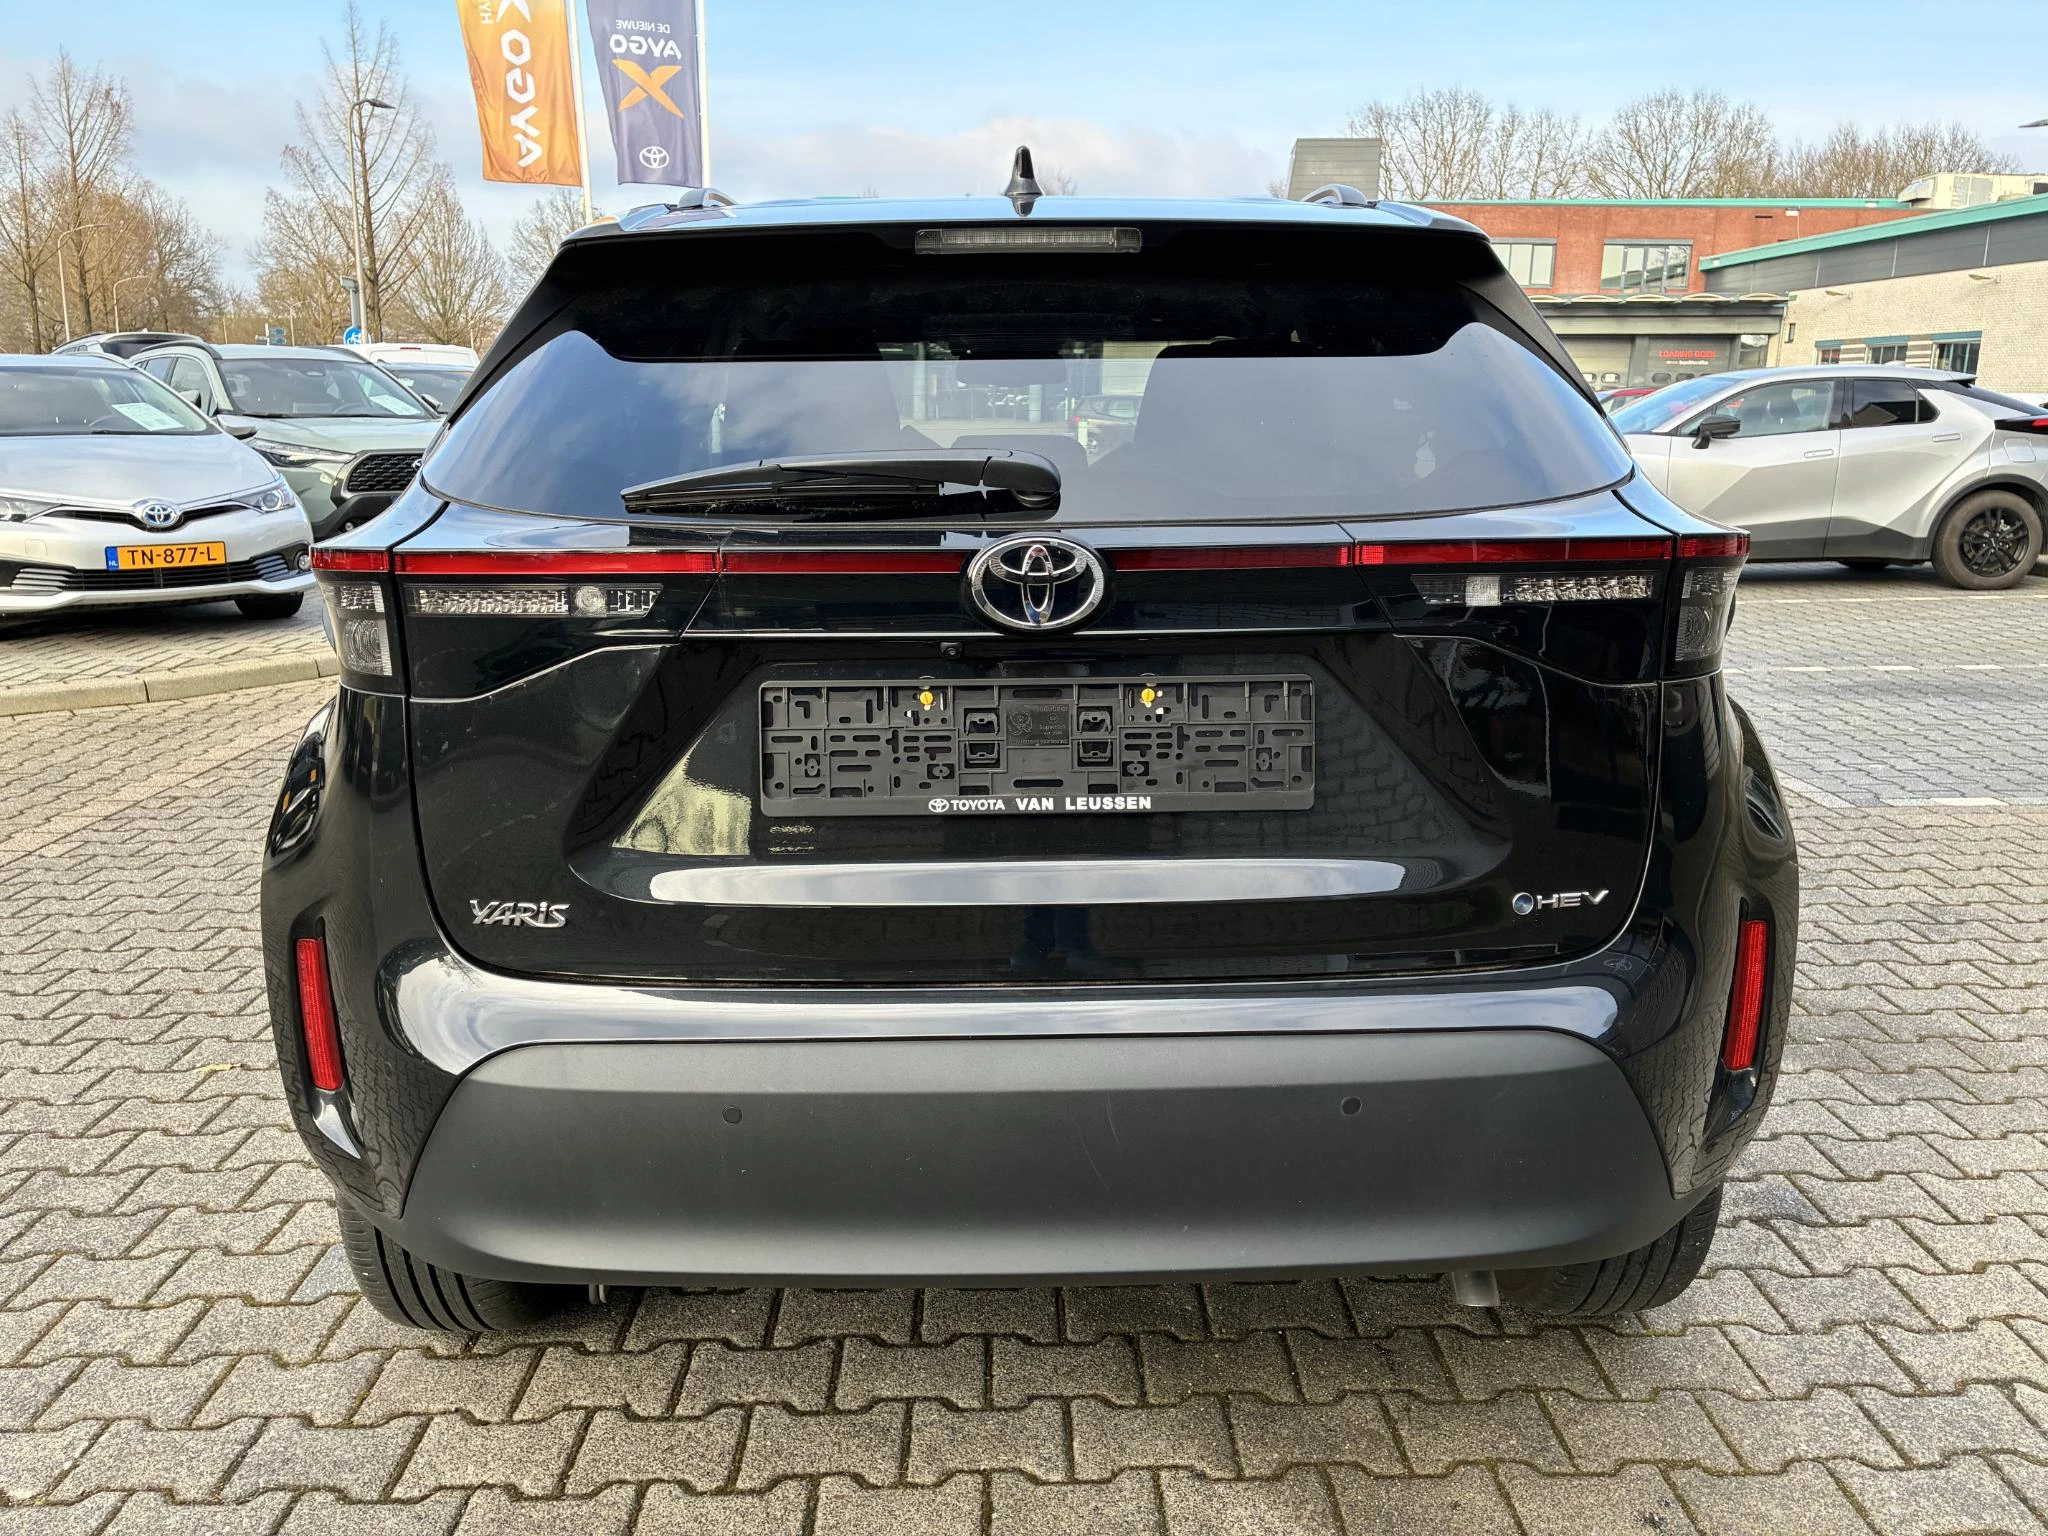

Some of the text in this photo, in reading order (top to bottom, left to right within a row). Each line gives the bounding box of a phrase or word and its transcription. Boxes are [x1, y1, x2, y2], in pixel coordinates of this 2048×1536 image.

[127, 546, 217, 566] TN-877-L
[950, 797, 1152, 811] TOYOTA VAN LEUSSEN
[1536, 889, 1610, 909] HEV
